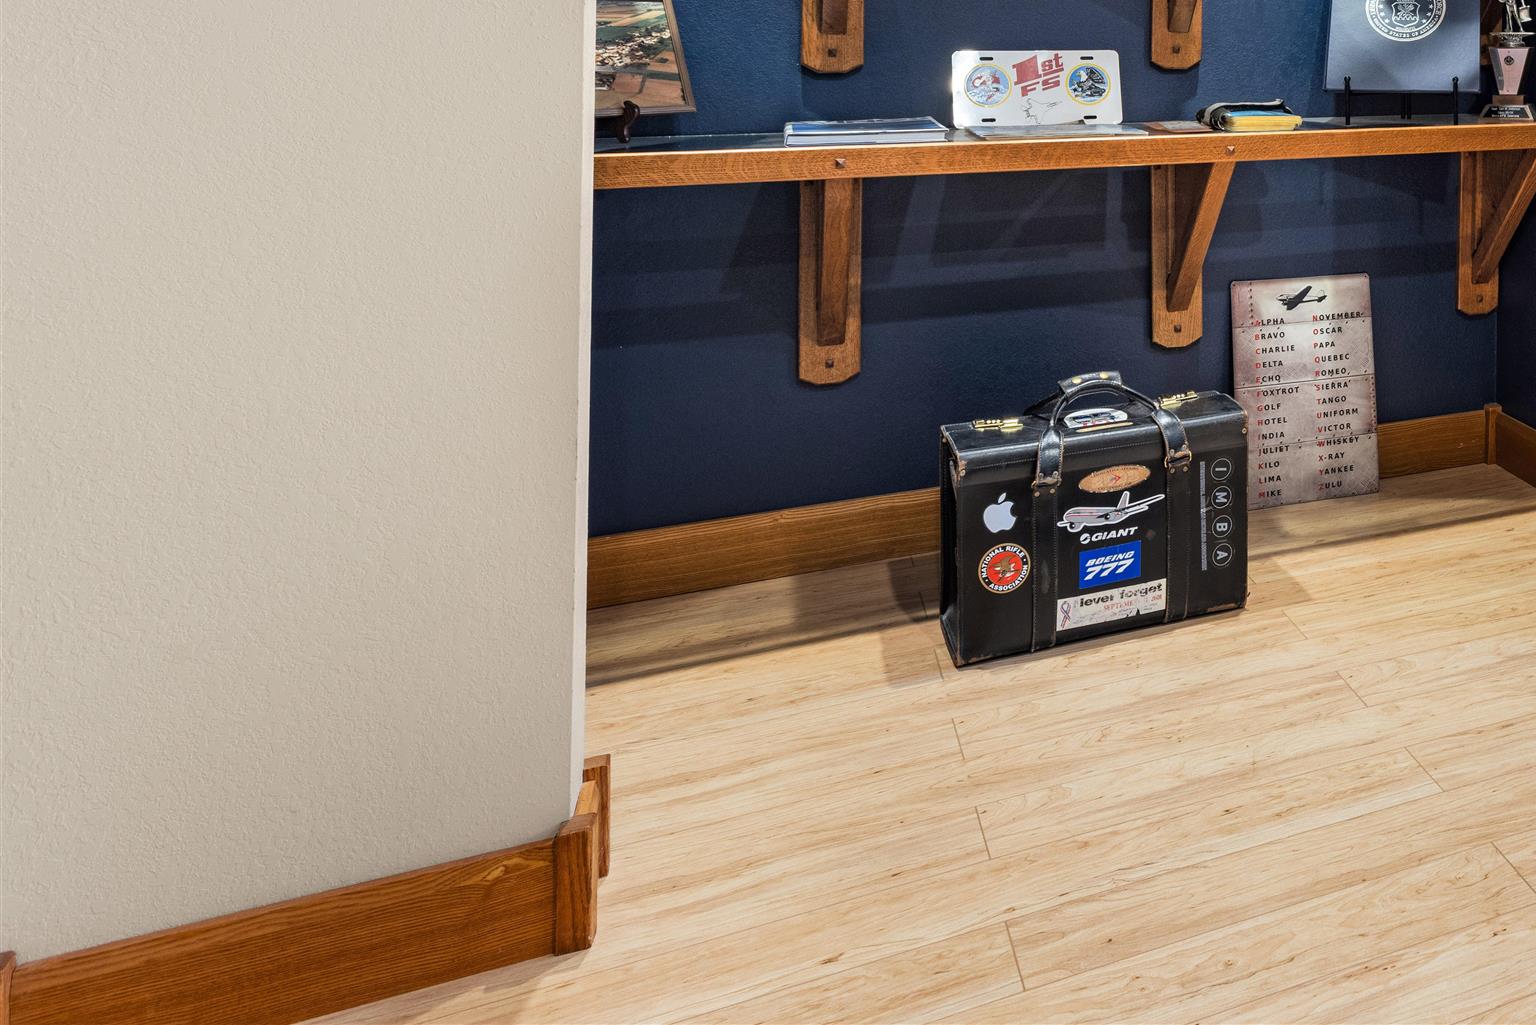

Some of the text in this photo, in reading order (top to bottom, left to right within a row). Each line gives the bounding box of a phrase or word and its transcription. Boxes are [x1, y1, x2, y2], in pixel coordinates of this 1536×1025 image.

[1012, 53, 1064, 86] 1st
[1020, 75, 1060, 97] FS
[1312, 311, 1361, 322] NOVEMBER
[1254, 317, 1285, 327] ALPHA
[1254, 331, 1285, 340] BRAVO
[1313, 326, 1342, 335] OSCAR
[1255, 345, 1295, 354] CHARLIE
[1313, 341, 1335, 349] PAPA
[1314, 353, 1350, 364] QUEBEC
[1255, 360, 1283, 369] DELTA
[1315, 367, 1347, 377] ROMEO
[1255, 375, 1281, 383] ECHO
[1316, 381, 1348, 391] SIERRA
[1257, 386, 1299, 397] FOXTROT
[1316, 396, 1346, 405] TANGO
[1257, 403, 1281, 412] GOLF
[1317, 408, 1358, 419] UNIFORM
[1257, 417, 1287, 426] HOTEL
[1317, 423, 1351, 433] VICTOR
[1258, 431, 1285, 440] INDIA
[1317, 436, 1359, 447] WHISKEY
[1258, 445, 1290, 457] JULIET
[1318, 452, 1345, 462] X-RAY
[1258, 461, 1280, 470] KILO
[1319, 465, 1354, 475] YANKEE
[1259, 475, 1281, 484] LIMA
[1318, 481, 1342, 491] ZULU
[1259, 489, 1281, 498] MIKE
[1091, 527, 1138, 542] GIANT
[981, 546, 1025, 578] NATIONAL RIFLE
[1085, 551, 1135, 567] BOEING
[1084, 558, 1135, 581] 777
[989, 565, 1028, 591] ASSOCIATION
